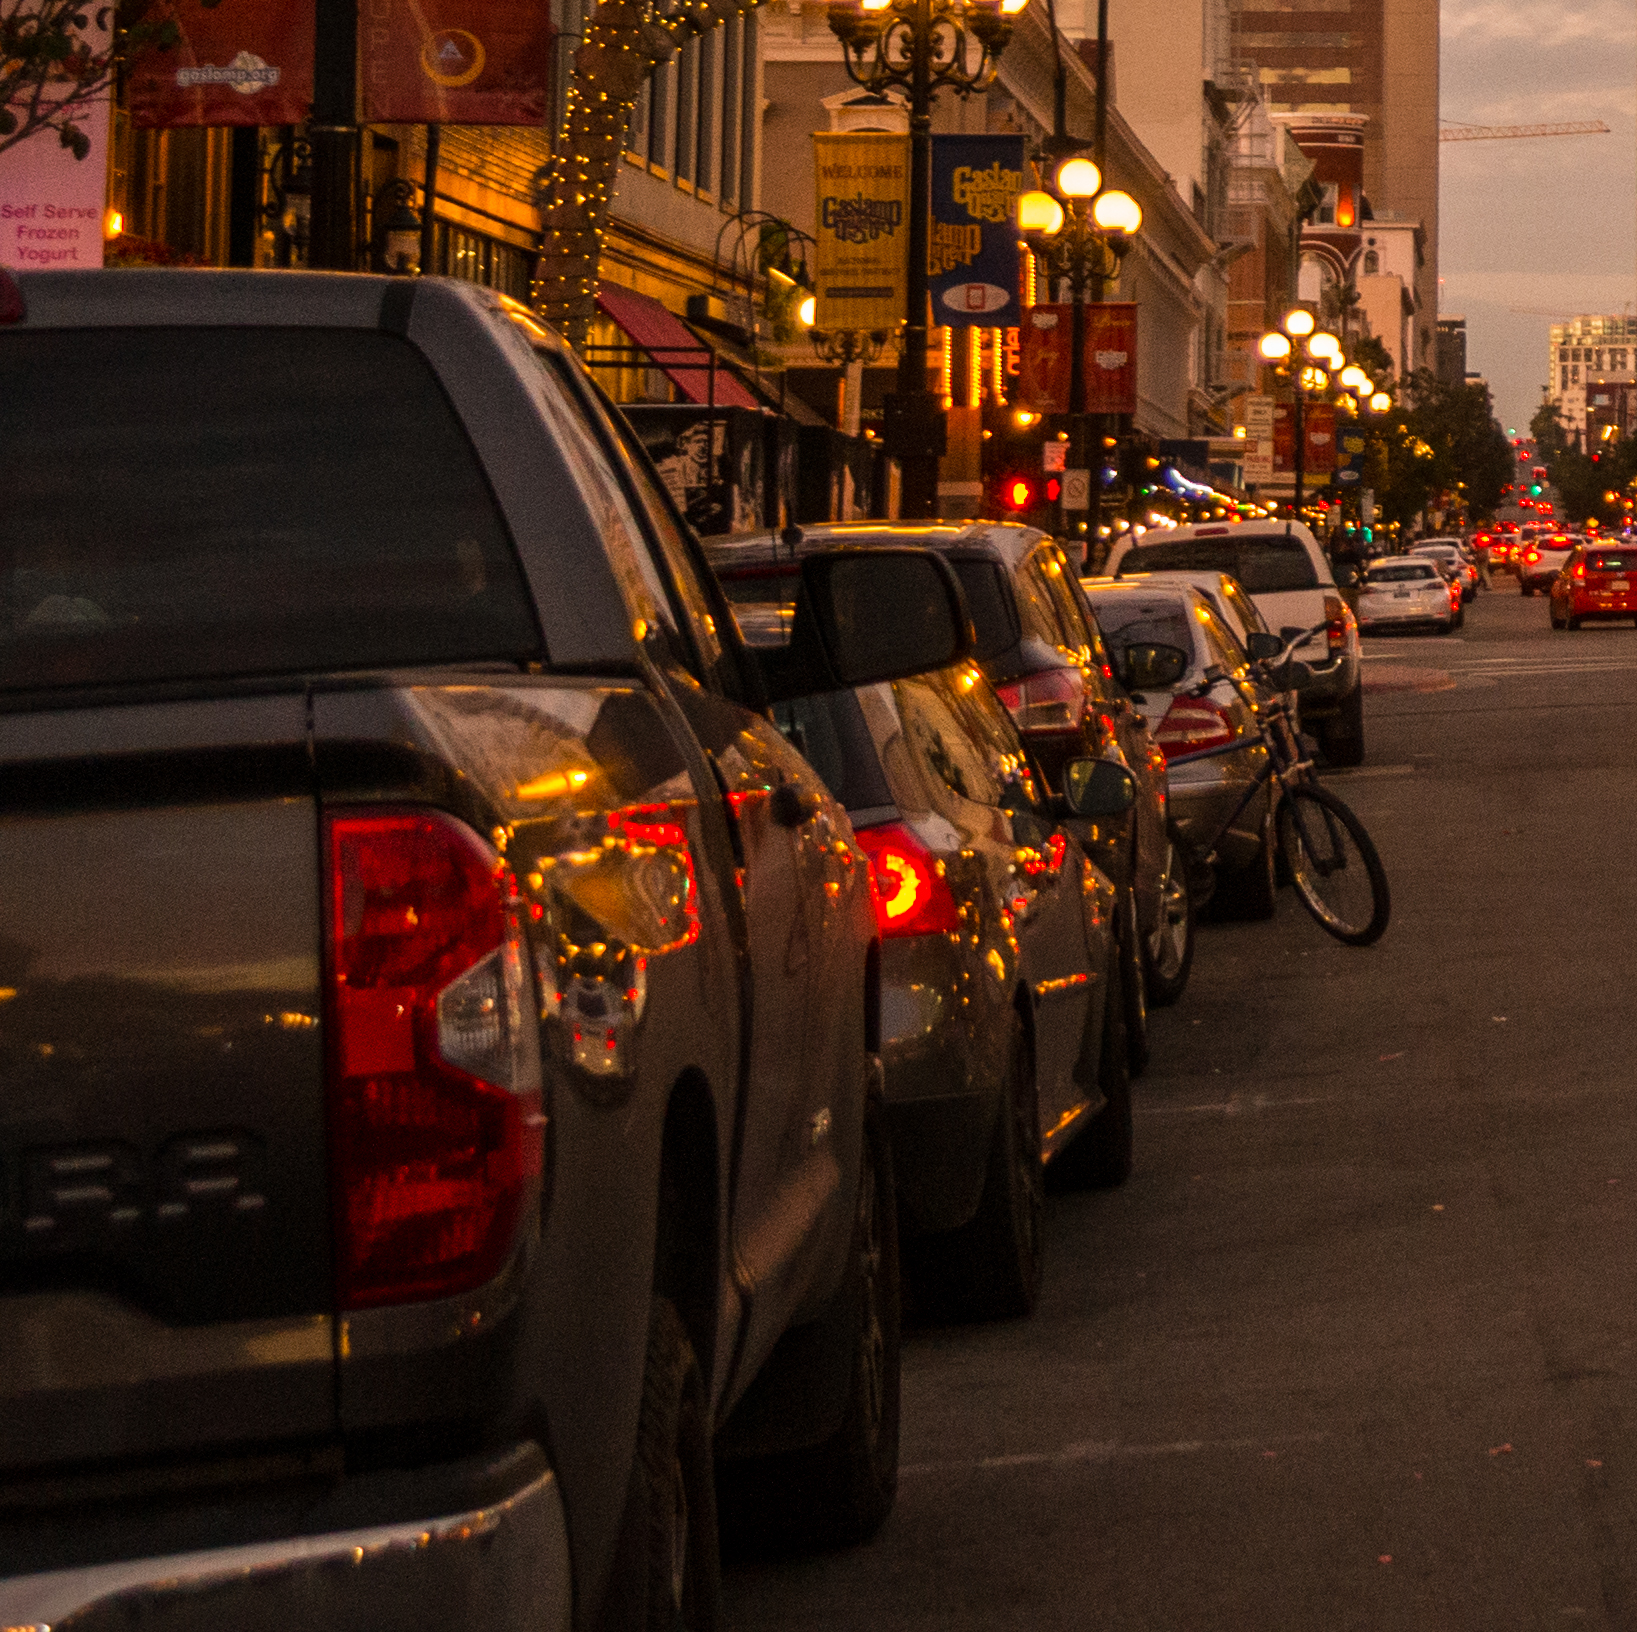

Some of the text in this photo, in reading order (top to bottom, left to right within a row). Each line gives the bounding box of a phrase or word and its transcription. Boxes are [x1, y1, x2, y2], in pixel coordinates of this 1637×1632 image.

[1, 204, 98, 219] Self Serve
[17, 225, 79, 240] Frozen
[18, 247, 79, 264] Yogurt
